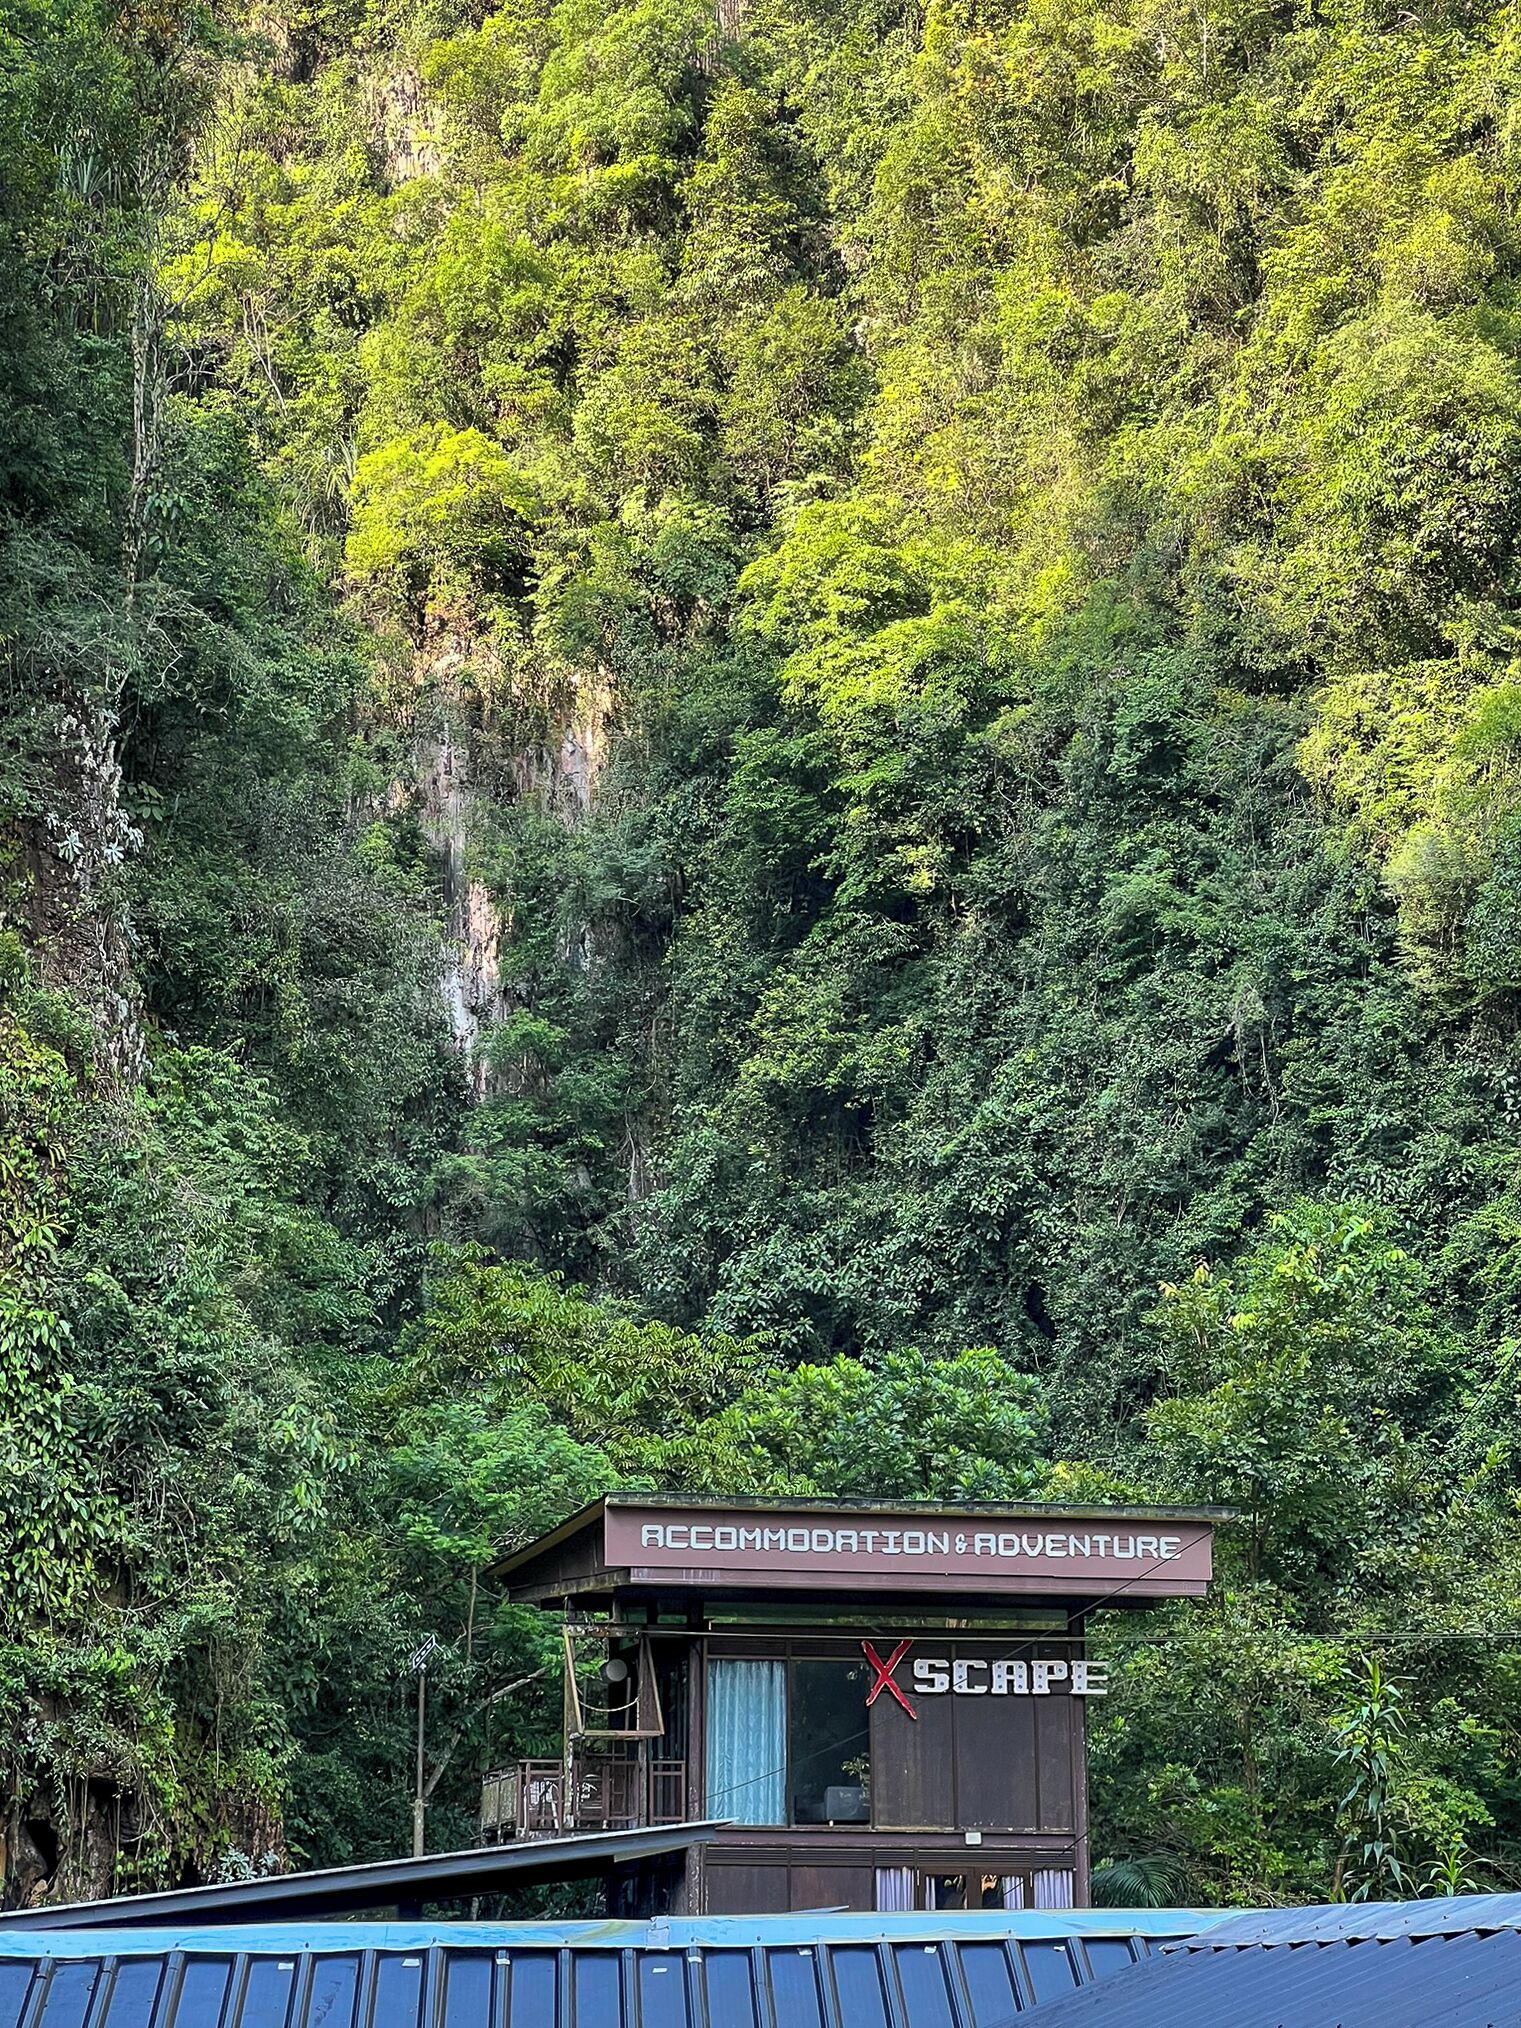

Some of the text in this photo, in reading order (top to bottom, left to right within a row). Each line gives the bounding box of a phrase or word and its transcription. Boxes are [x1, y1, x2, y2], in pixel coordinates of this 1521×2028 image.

[641, 1524, 1182, 1560] ACCOMMODATION & ADVENTURE
